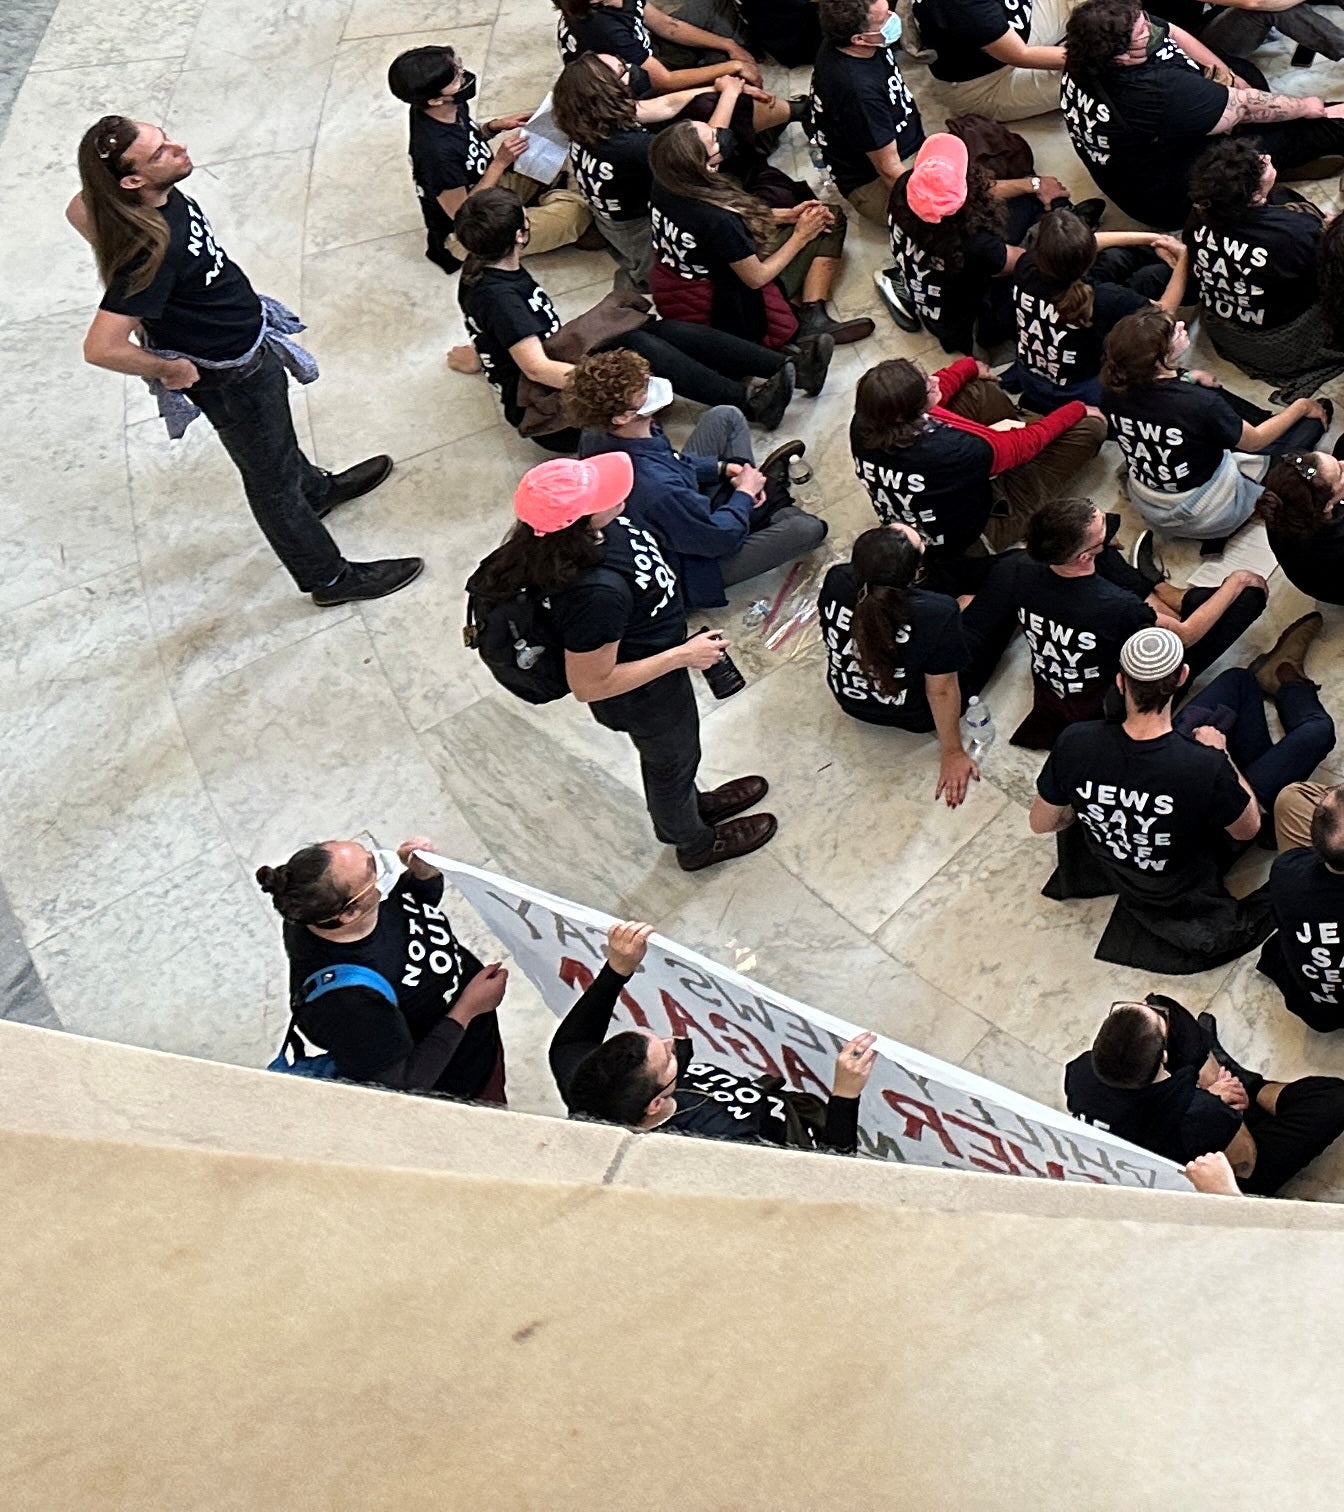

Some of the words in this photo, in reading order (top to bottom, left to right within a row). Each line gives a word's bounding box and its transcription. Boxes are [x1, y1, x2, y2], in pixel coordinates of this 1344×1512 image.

[1018, 608, 1097, 650] JEWS
[1076, 781, 1174, 816] JEWS
[1086, 803, 1158, 835] SAY
[422, 903, 454, 975] OUR
